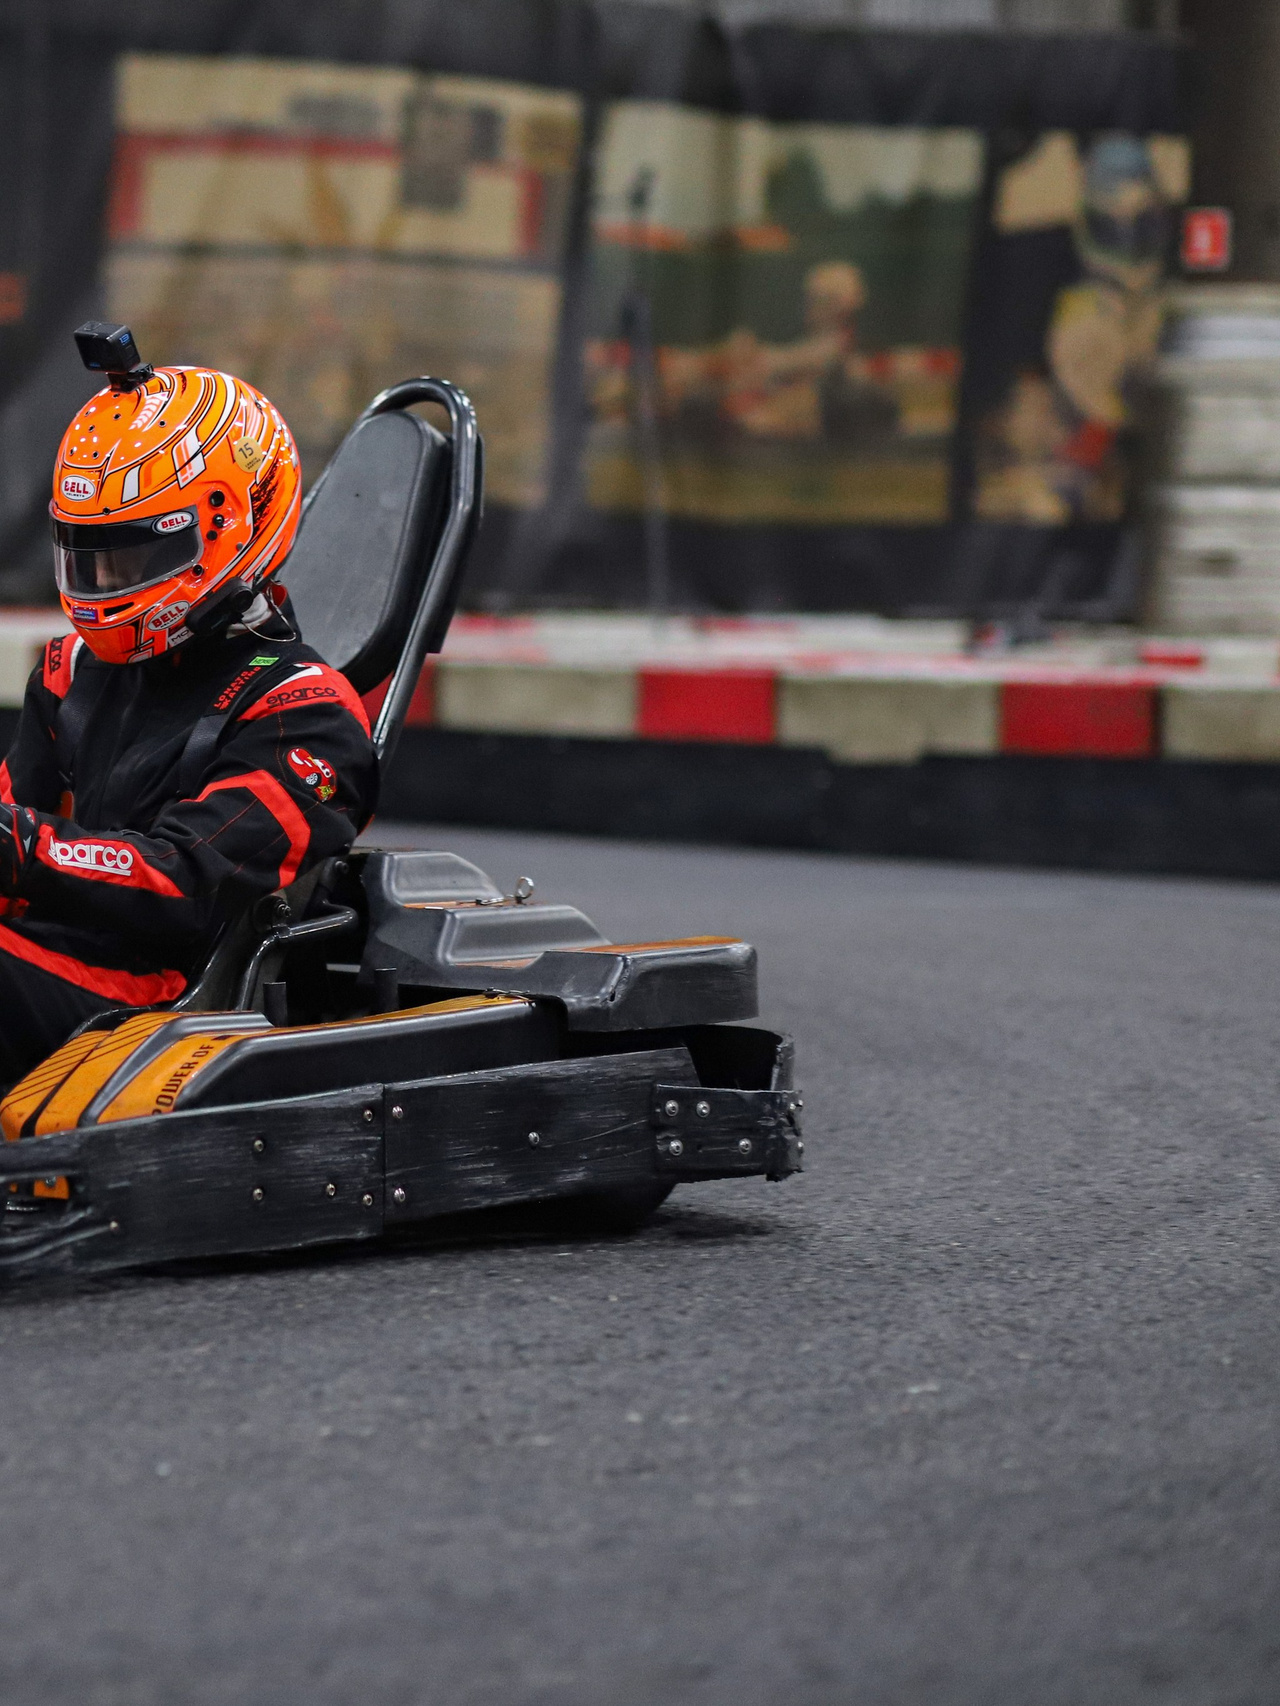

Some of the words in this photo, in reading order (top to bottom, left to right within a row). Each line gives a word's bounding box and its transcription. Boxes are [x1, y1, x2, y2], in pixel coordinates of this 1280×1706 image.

[238, 442, 254, 459] 15
[64, 480, 89, 495] BELL
[161, 515, 189, 529] BELL
[151, 606, 185, 628] BELL
[266, 687, 339, 709] sparco
[191, 1044, 214, 1057] OF
